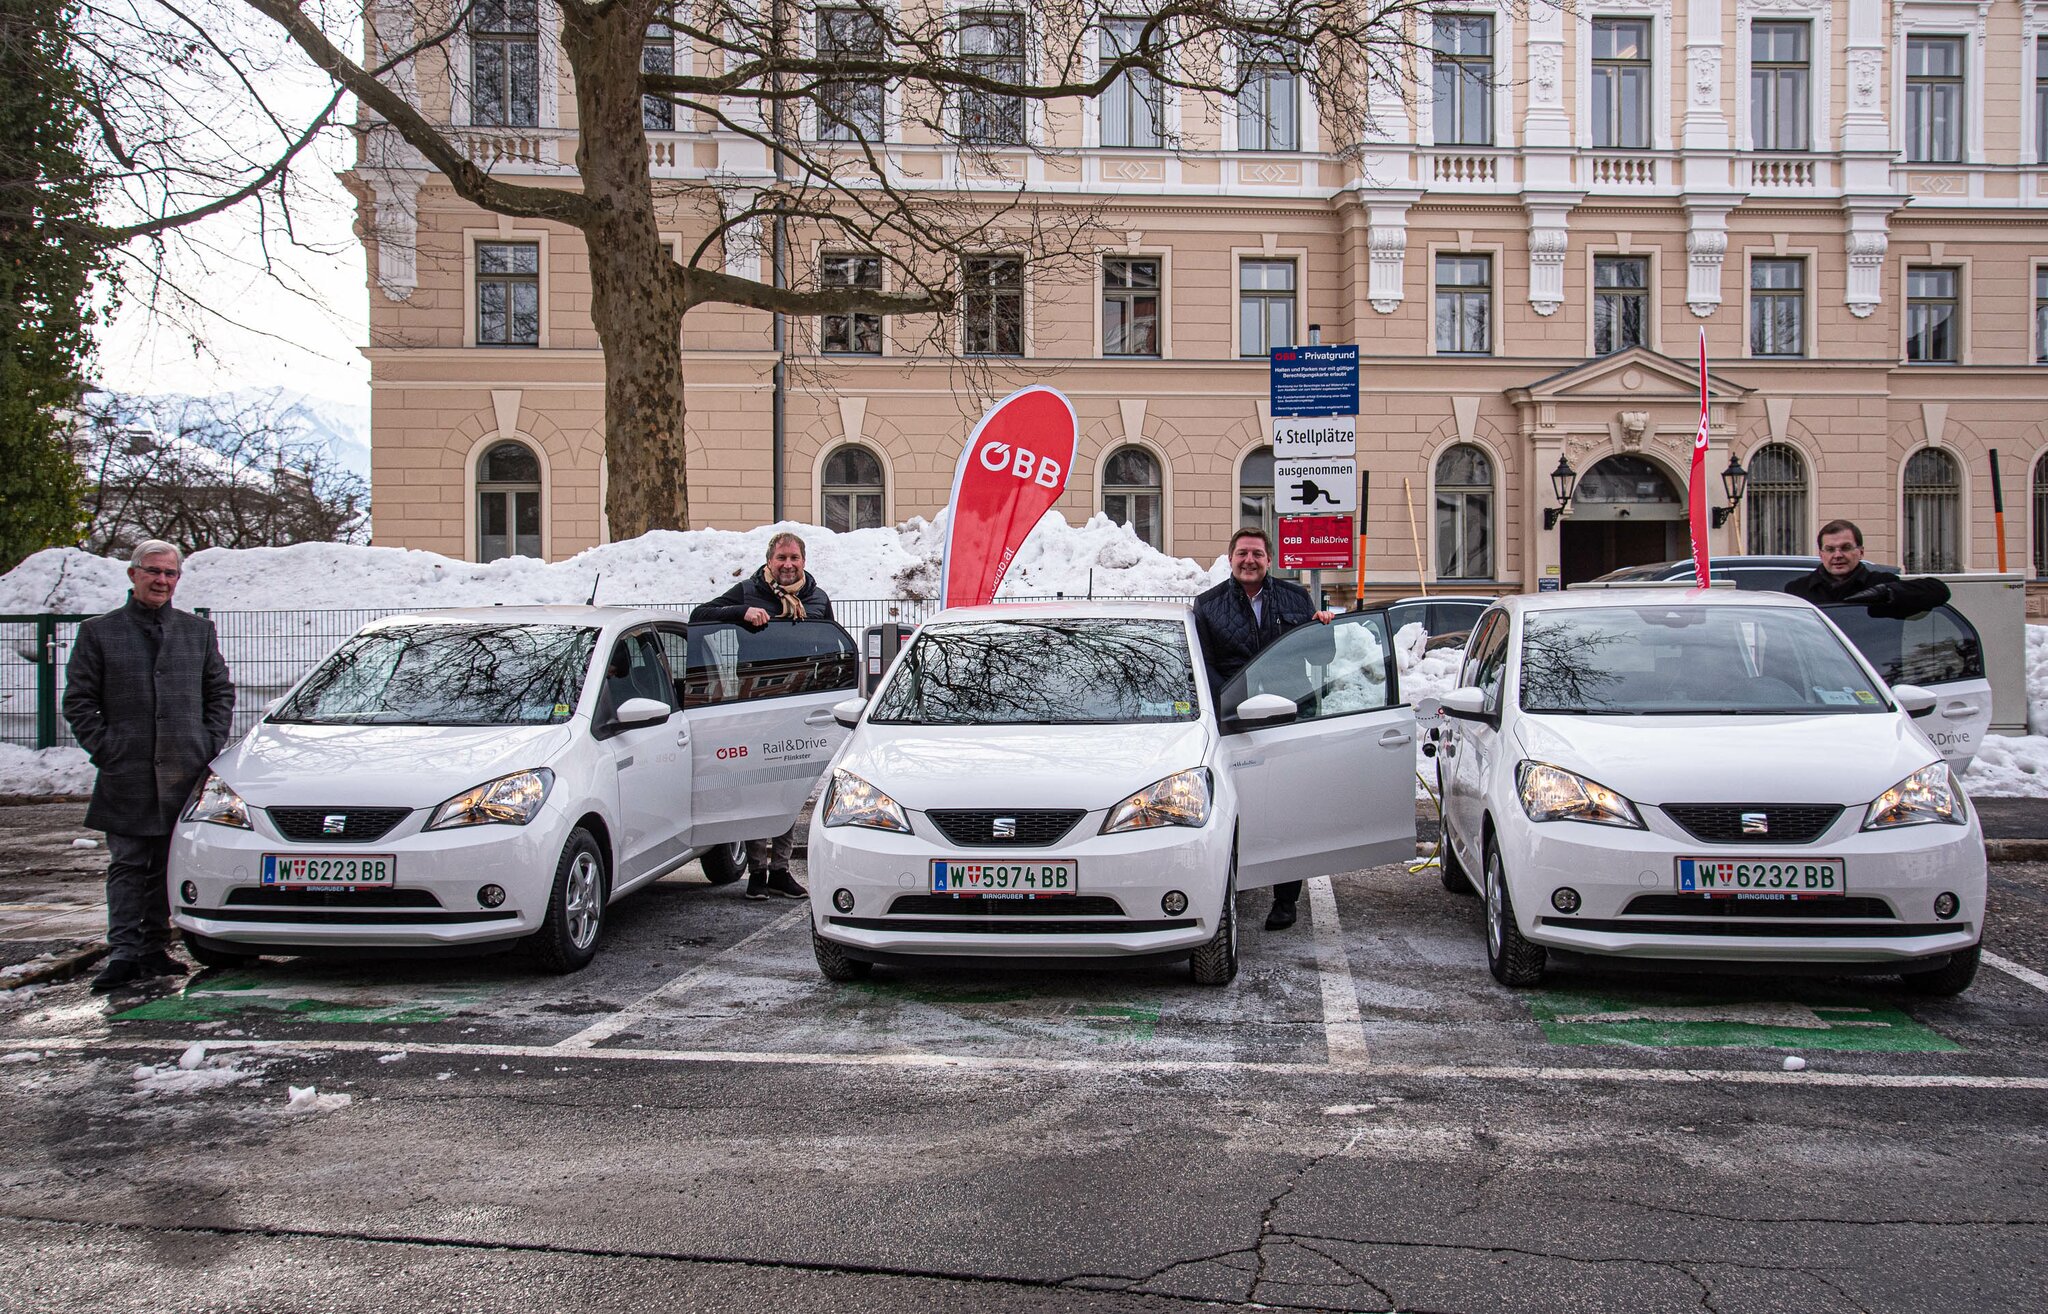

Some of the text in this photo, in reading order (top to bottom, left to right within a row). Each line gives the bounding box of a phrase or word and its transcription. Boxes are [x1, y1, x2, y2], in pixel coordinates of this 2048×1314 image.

[1304, 351, 1355, 361] Privatgrund
[1275, 428, 1354, 446] 4 Stellplätze
[980, 441, 1061, 488] ÖBB
[1278, 465, 1353, 478] ausgenommen
[1283, 536, 1303, 544] ÖBB
[1310, 535, 1349, 544] Rail&Drive
[716, 745, 749, 760] ÖBB
[763, 737, 827, 754] Rail&Drive
[783, 753, 811, 761] Flinkster
[279, 860, 293, 880] W
[307, 860, 357, 881] 6223
[361, 861, 386, 881] BB
[950, 866, 965, 888] W
[982, 866, 1036, 888] 5974
[1041, 866, 1068, 888] BB
[1699, 864, 1716, 887] W
[1737, 864, 1799, 888] 6232
[1804, 865, 1835, 888] BB
